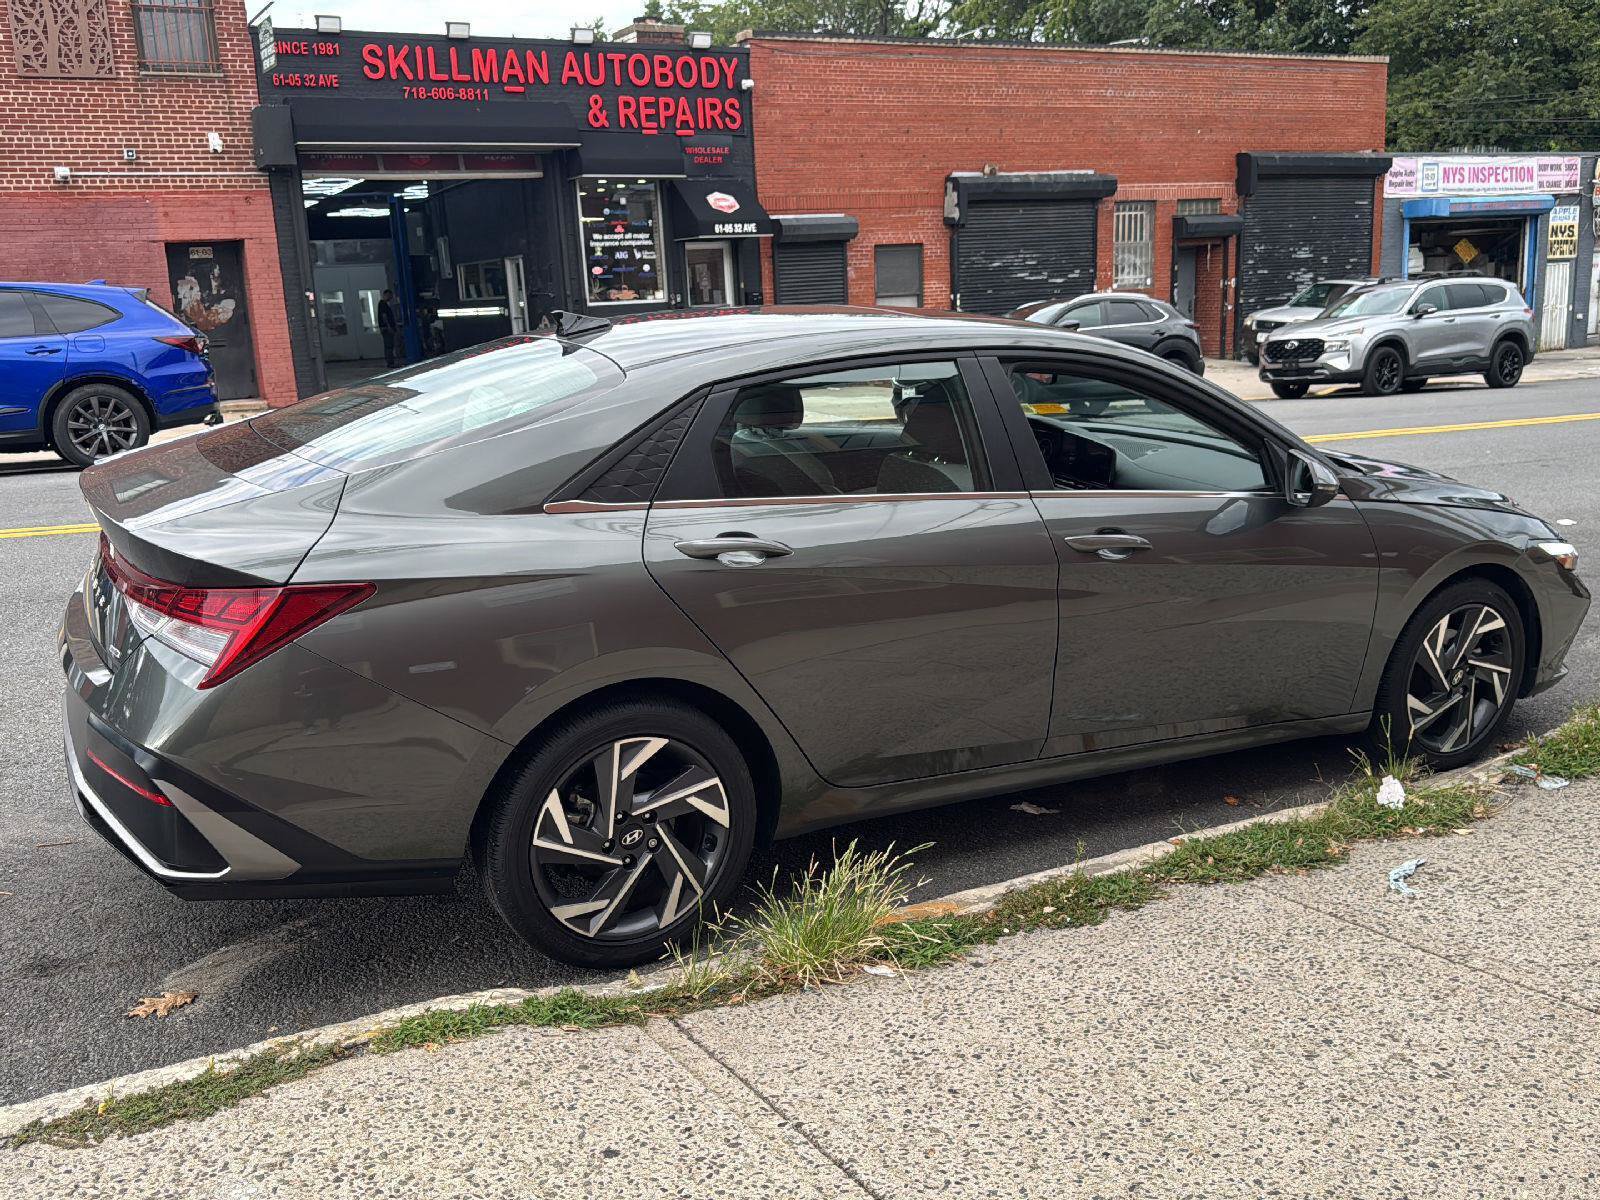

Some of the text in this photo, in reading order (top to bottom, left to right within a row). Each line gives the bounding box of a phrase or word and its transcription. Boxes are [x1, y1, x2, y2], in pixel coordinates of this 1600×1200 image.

[273, 41, 340, 55] SINCE 1981
[362, 43, 738, 89] SKILLMAN AUTOBODY
[273, 73, 339, 88] 61-05 32 AVE
[403, 86, 489, 101] 718-606-8811
[588, 94, 742, 131] & REPAIRS
[685, 146, 730, 155] WHOLESALE
[693, 156, 723, 164] DEALER
[1442, 166, 1466, 184] NYS
[1468, 166, 1534, 183] INSPECTION
[733, 223, 743, 233] 32
[743, 222, 757, 233] AVE
[614, 251, 629, 260] AIG
